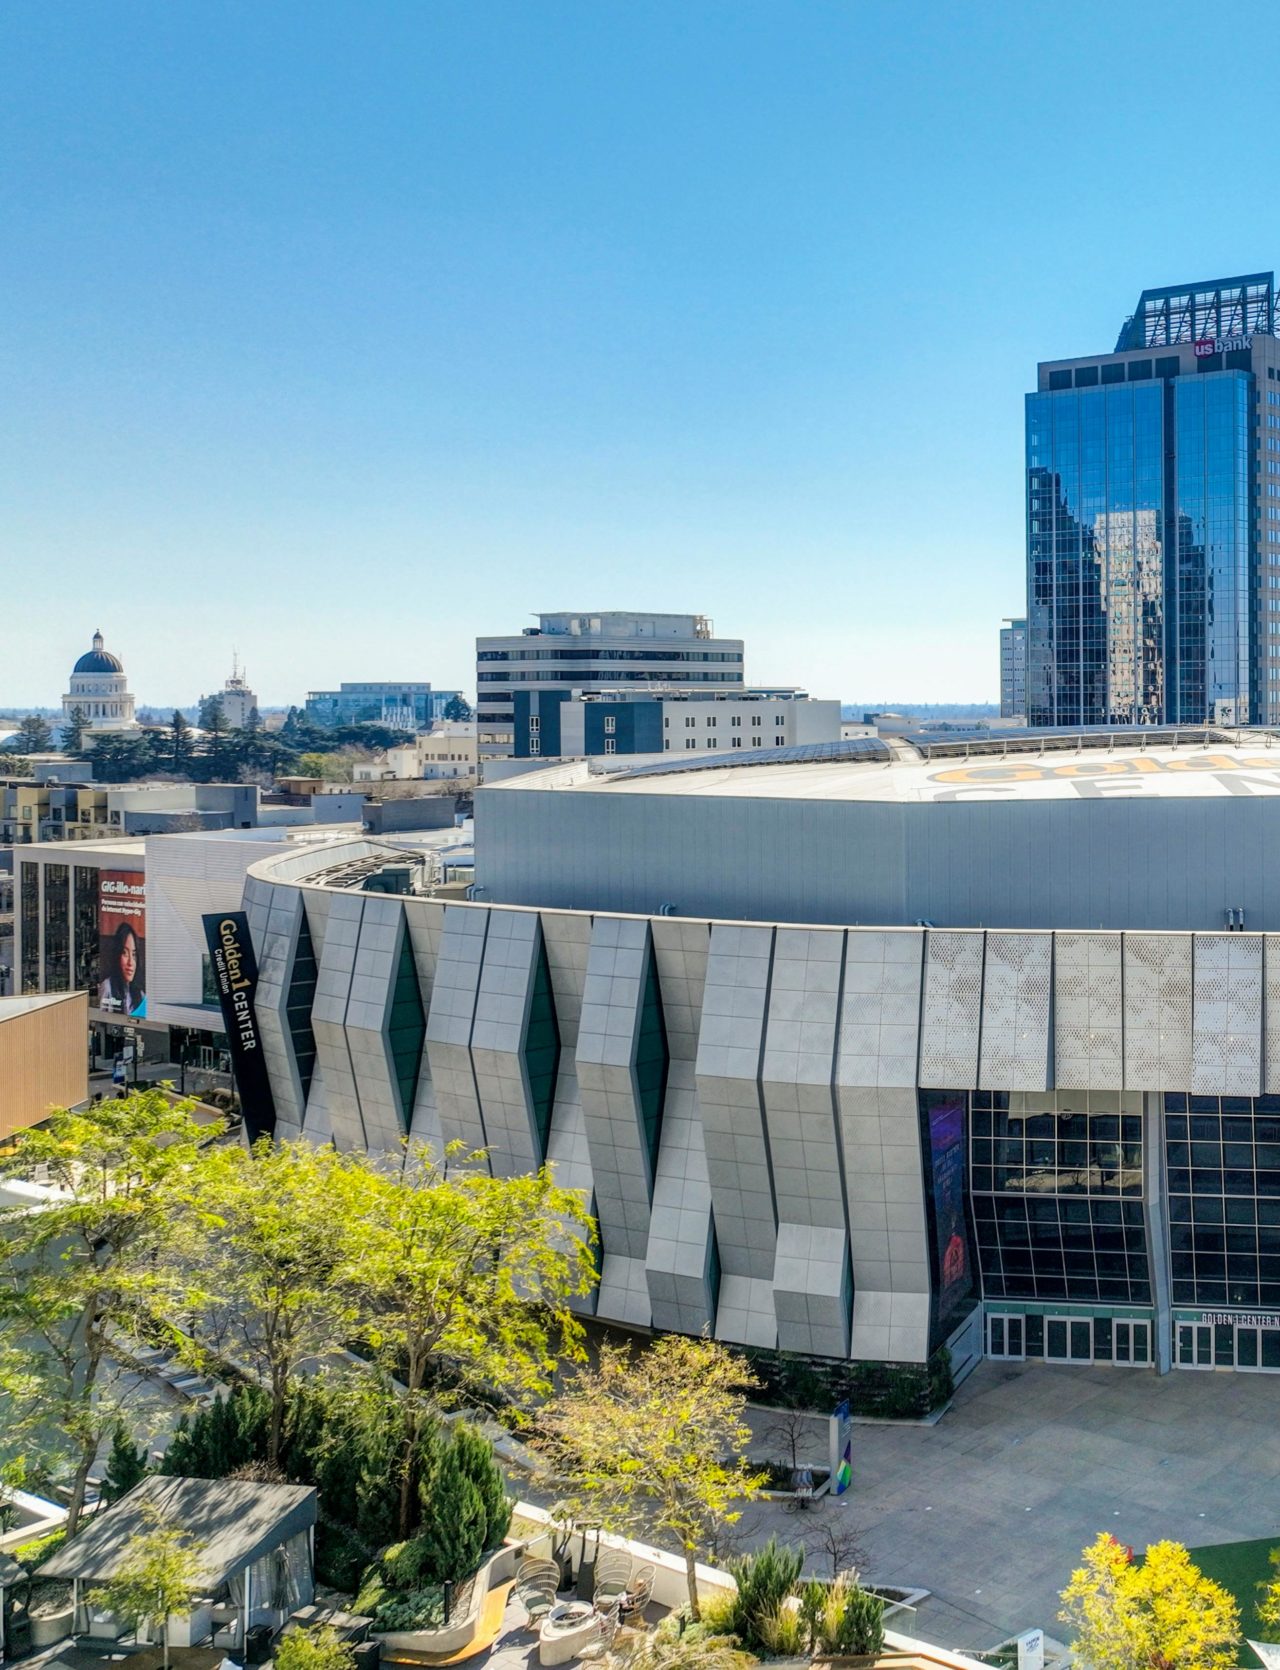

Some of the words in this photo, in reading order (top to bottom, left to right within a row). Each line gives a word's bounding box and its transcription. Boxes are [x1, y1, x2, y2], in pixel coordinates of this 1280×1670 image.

[214, 948, 226, 972] Credit
[219, 970, 230, 994] Union
[232, 991, 257, 1051] CENTER
[1202, 1313, 1233, 1326] GOLDEN
[1241, 1314, 1272, 1327] CENTER
